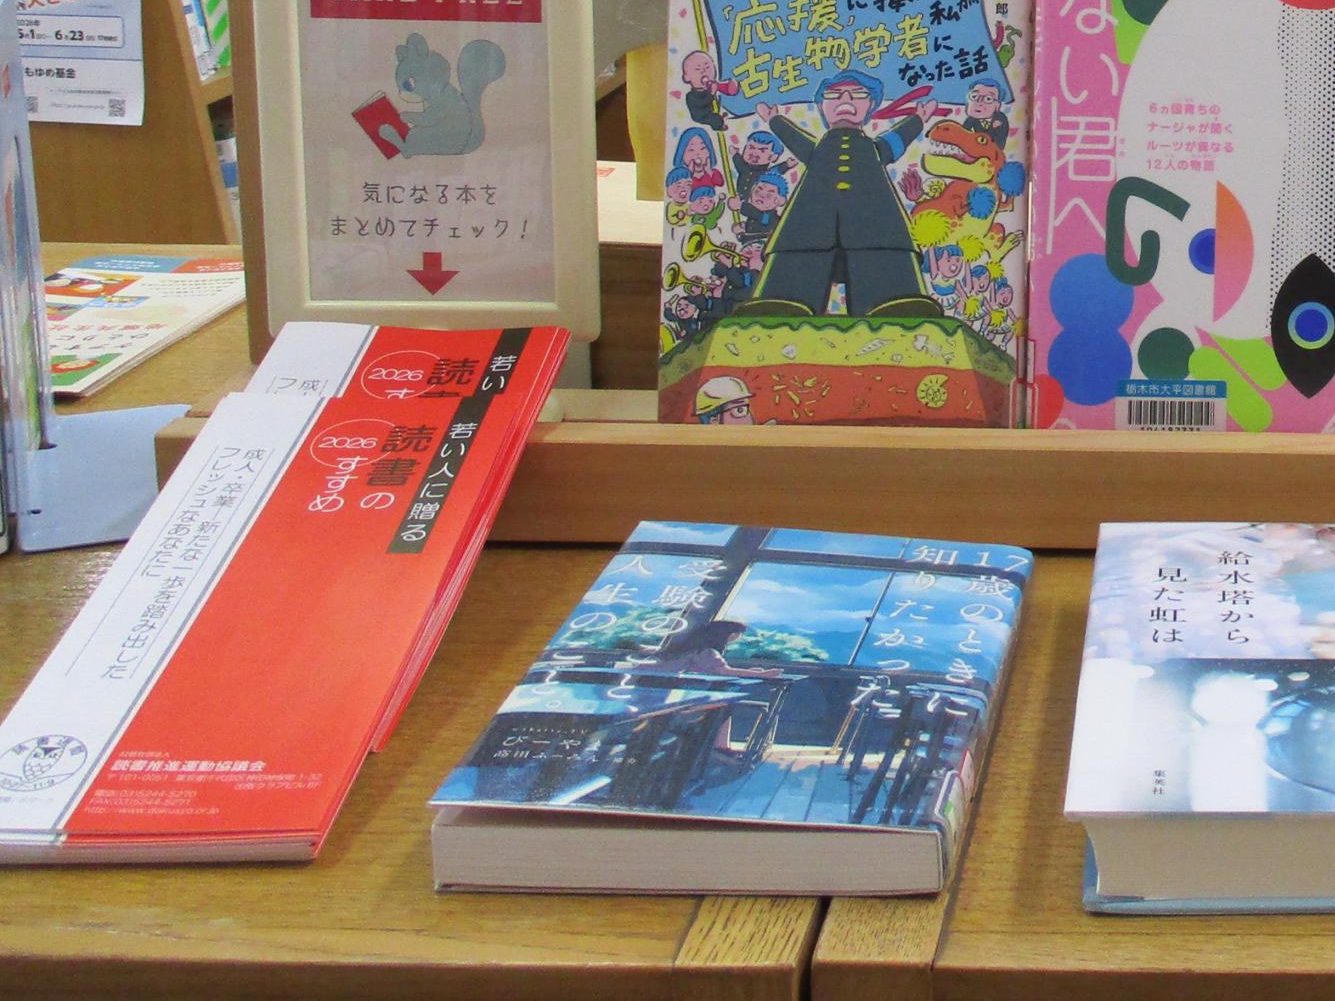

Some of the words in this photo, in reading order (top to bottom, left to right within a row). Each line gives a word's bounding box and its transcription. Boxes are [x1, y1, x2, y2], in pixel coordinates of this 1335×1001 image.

[733, 13, 930, 98] 古生物学者
[899, 46, 989, 86] なった話
[363, 183, 498, 206] 気になる本を
[330, 218, 529, 240] まとめてチェック！
[367, 367, 424, 382] 2026
[482, 355, 518, 392] 若い
[318, 437, 377, 449] 2026
[360, 424, 437, 510] 読書の
[308, 455, 368, 513] すすめ
[400, 422, 478, 542] 若い人に贈る
[141, 447, 241, 577] フレッシュなあなたに
[851, 545, 959, 708] 知りたかった
[1149, 567, 1188, 644] 見た虹は
[1217, 551, 1255, 646] 給水塔から
[926, 550, 1029, 717] 17歳のときに
[110, 760, 266, 773] 読書推進運動協議会
[1152, 769, 1167, 795] 集英社
